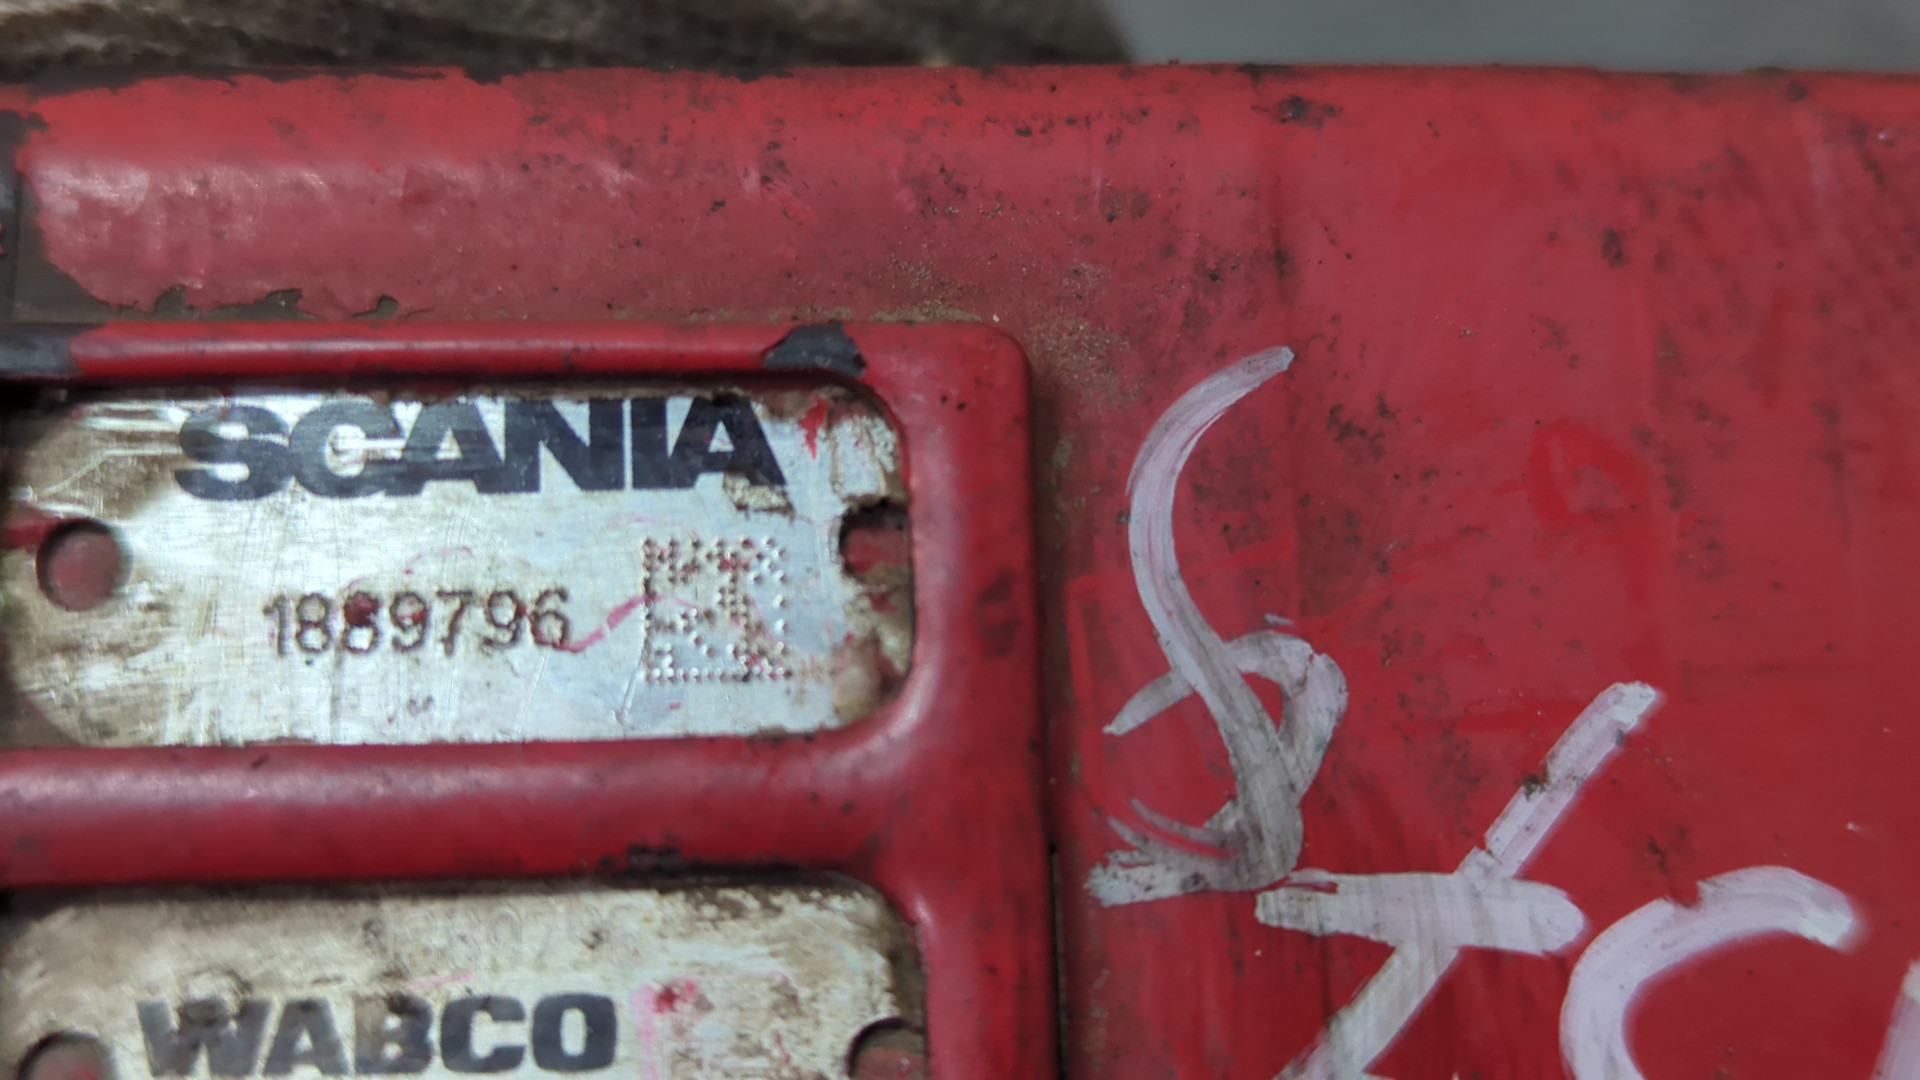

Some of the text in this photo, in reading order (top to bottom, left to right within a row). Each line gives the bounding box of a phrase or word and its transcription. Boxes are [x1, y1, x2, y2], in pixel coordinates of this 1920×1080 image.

[174, 396, 788, 499] SCANIA
[262, 586, 569, 657] 1889796
[137, 992, 617, 1078] WABCO
